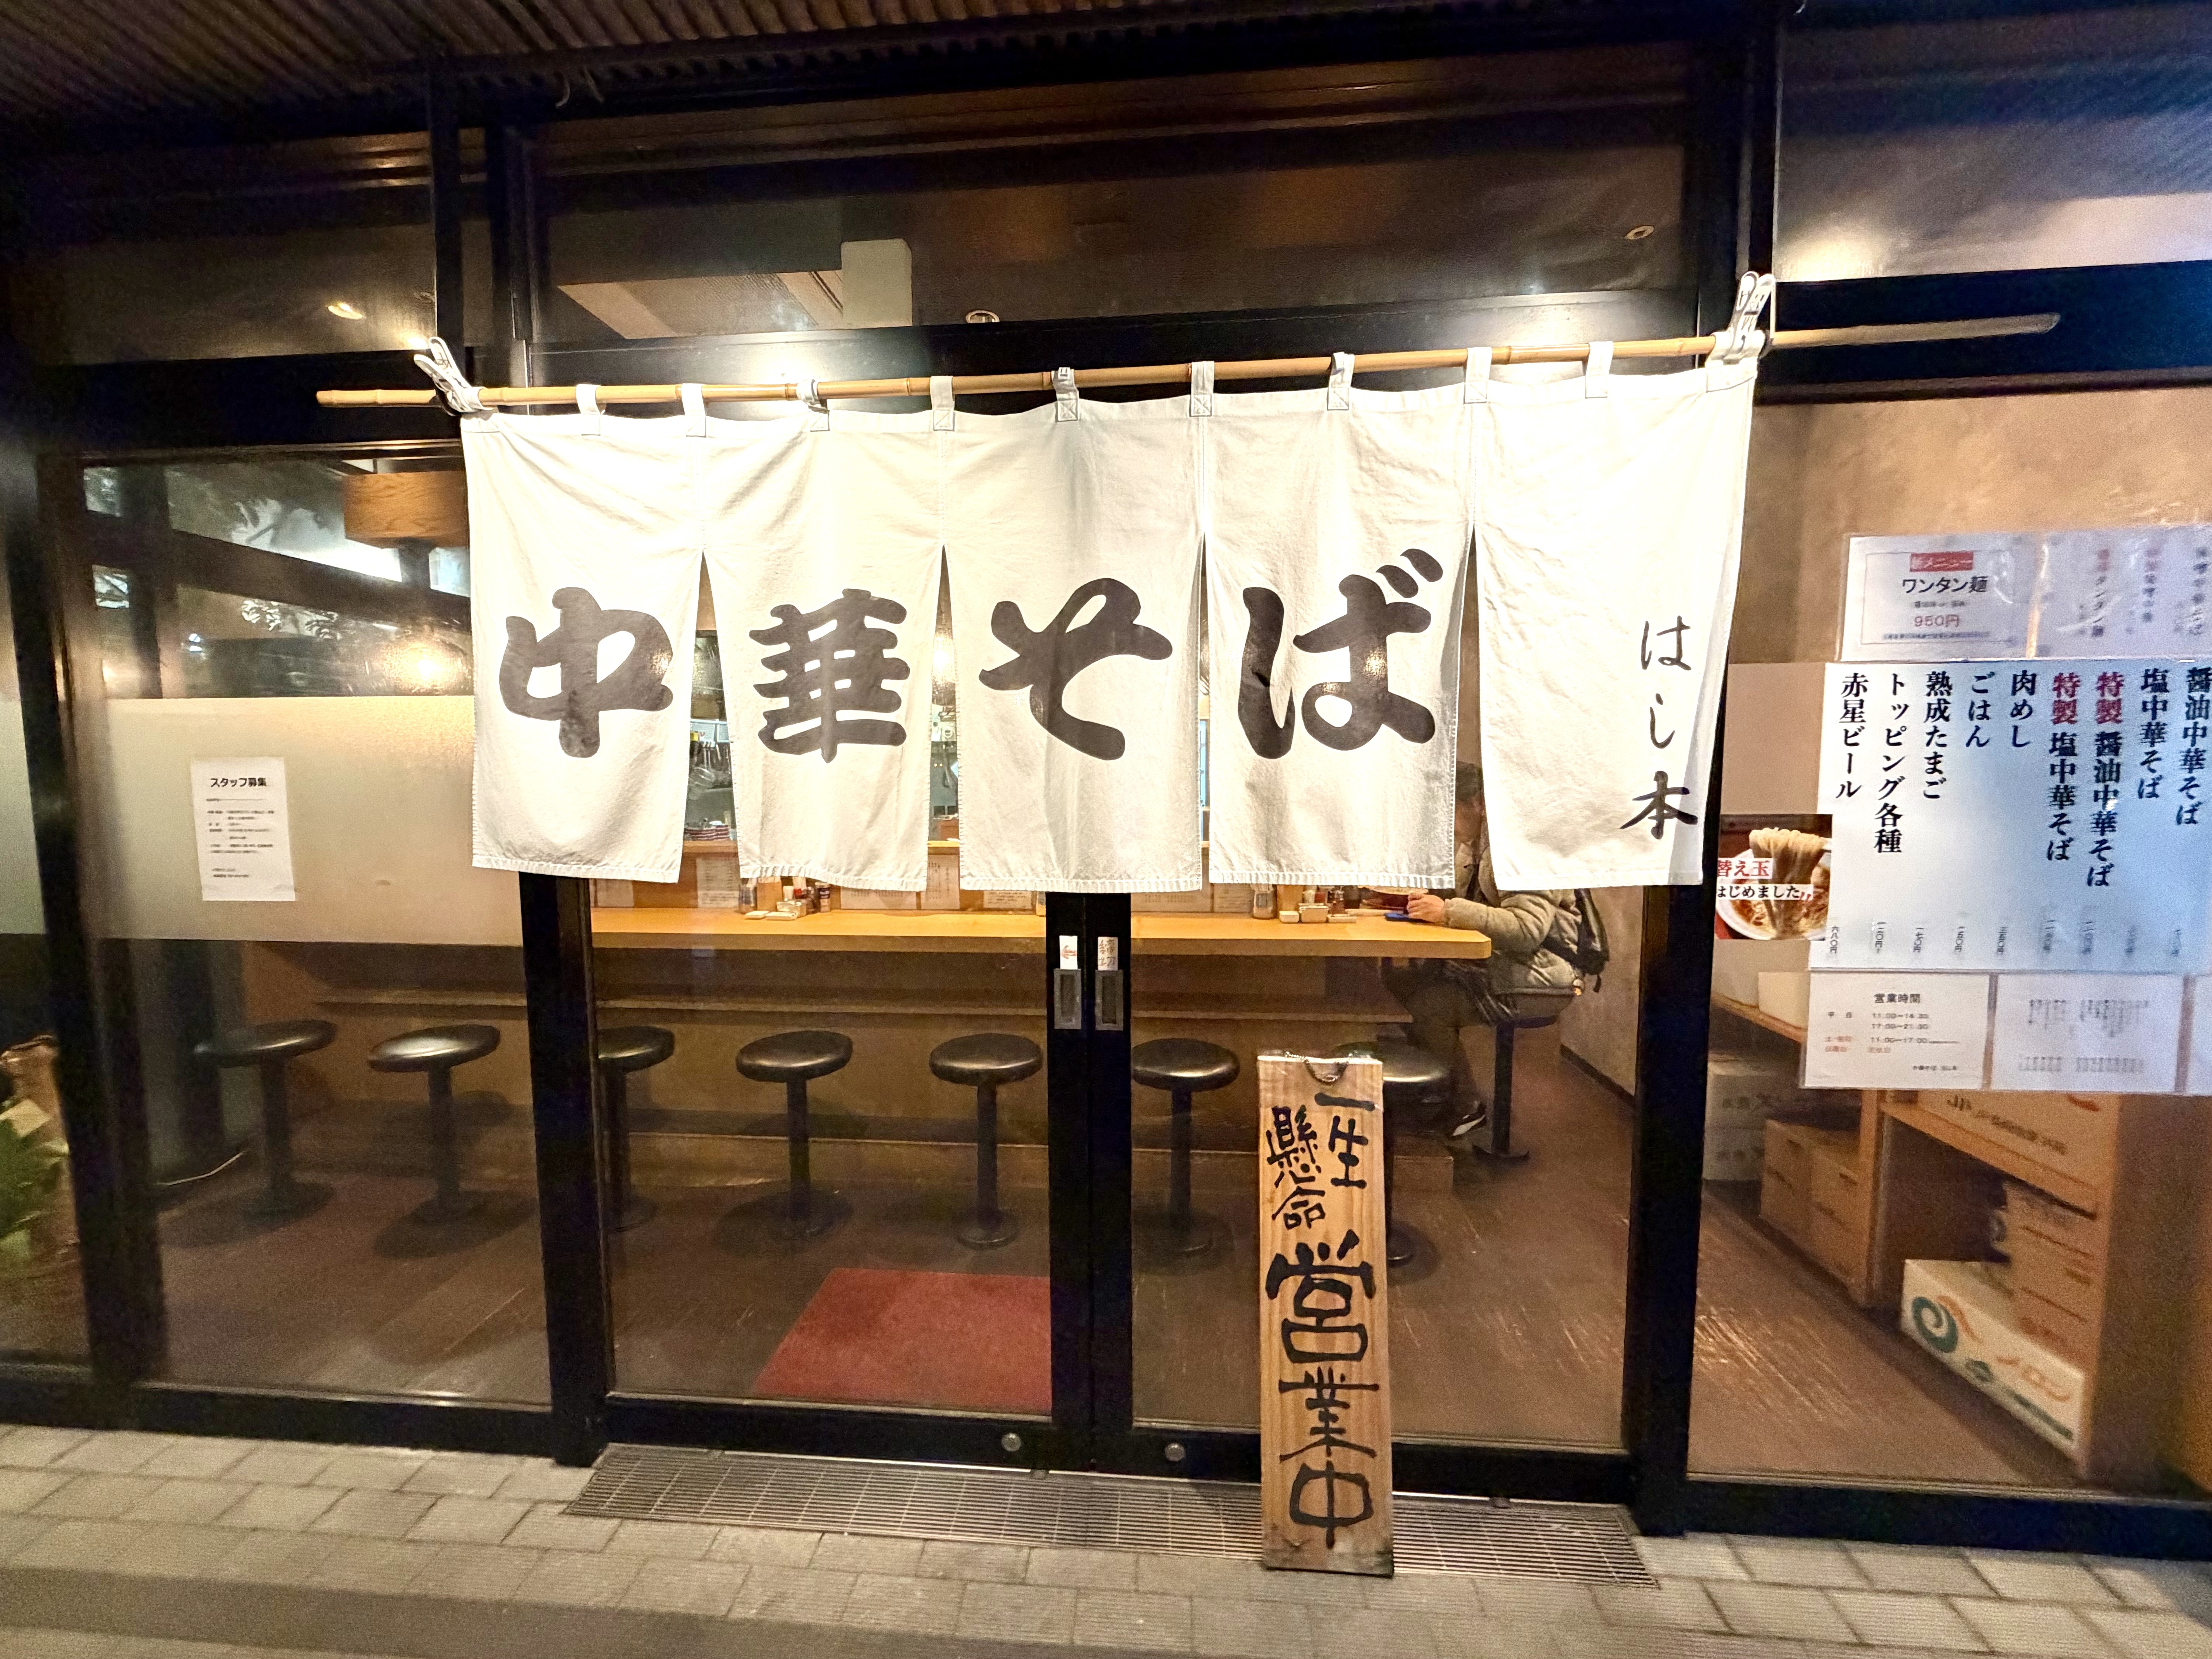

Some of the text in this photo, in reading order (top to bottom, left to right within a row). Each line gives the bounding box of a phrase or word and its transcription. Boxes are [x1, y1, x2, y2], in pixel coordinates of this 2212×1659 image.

[1902, 576, 1988, 593] ワンタン麺
[1914, 614, 1960, 627] 950円
[499, 548, 1444, 764] 中華そば
[1965, 671, 1996, 748] ごはん
[2010, 670, 2037, 748] 肉めし
[2095, 671, 2125, 725] 特製
[210, 778, 267, 788] スタッフ募集
[1619, 615, 1698, 840] はし本
[1835, 672, 1869, 799] 赤星ビール
[1874, 673, 1909, 854] トッピング各種
[1923, 671, 1953, 799] 熟成たまご
[2046, 672, 2081, 861] 特製 塩中華そば
[2137, 668, 2170, 800] 塩中華そば
[2176, 667, 2212, 825] 醤油中華そば
[1717, 860, 1770, 877] 替え玉
[2087, 731, 2123, 887] 醤油中華そば
[1874, 993, 1921, 1003] 営業時間
[1265, 1228, 1379, 1549] 営業中
